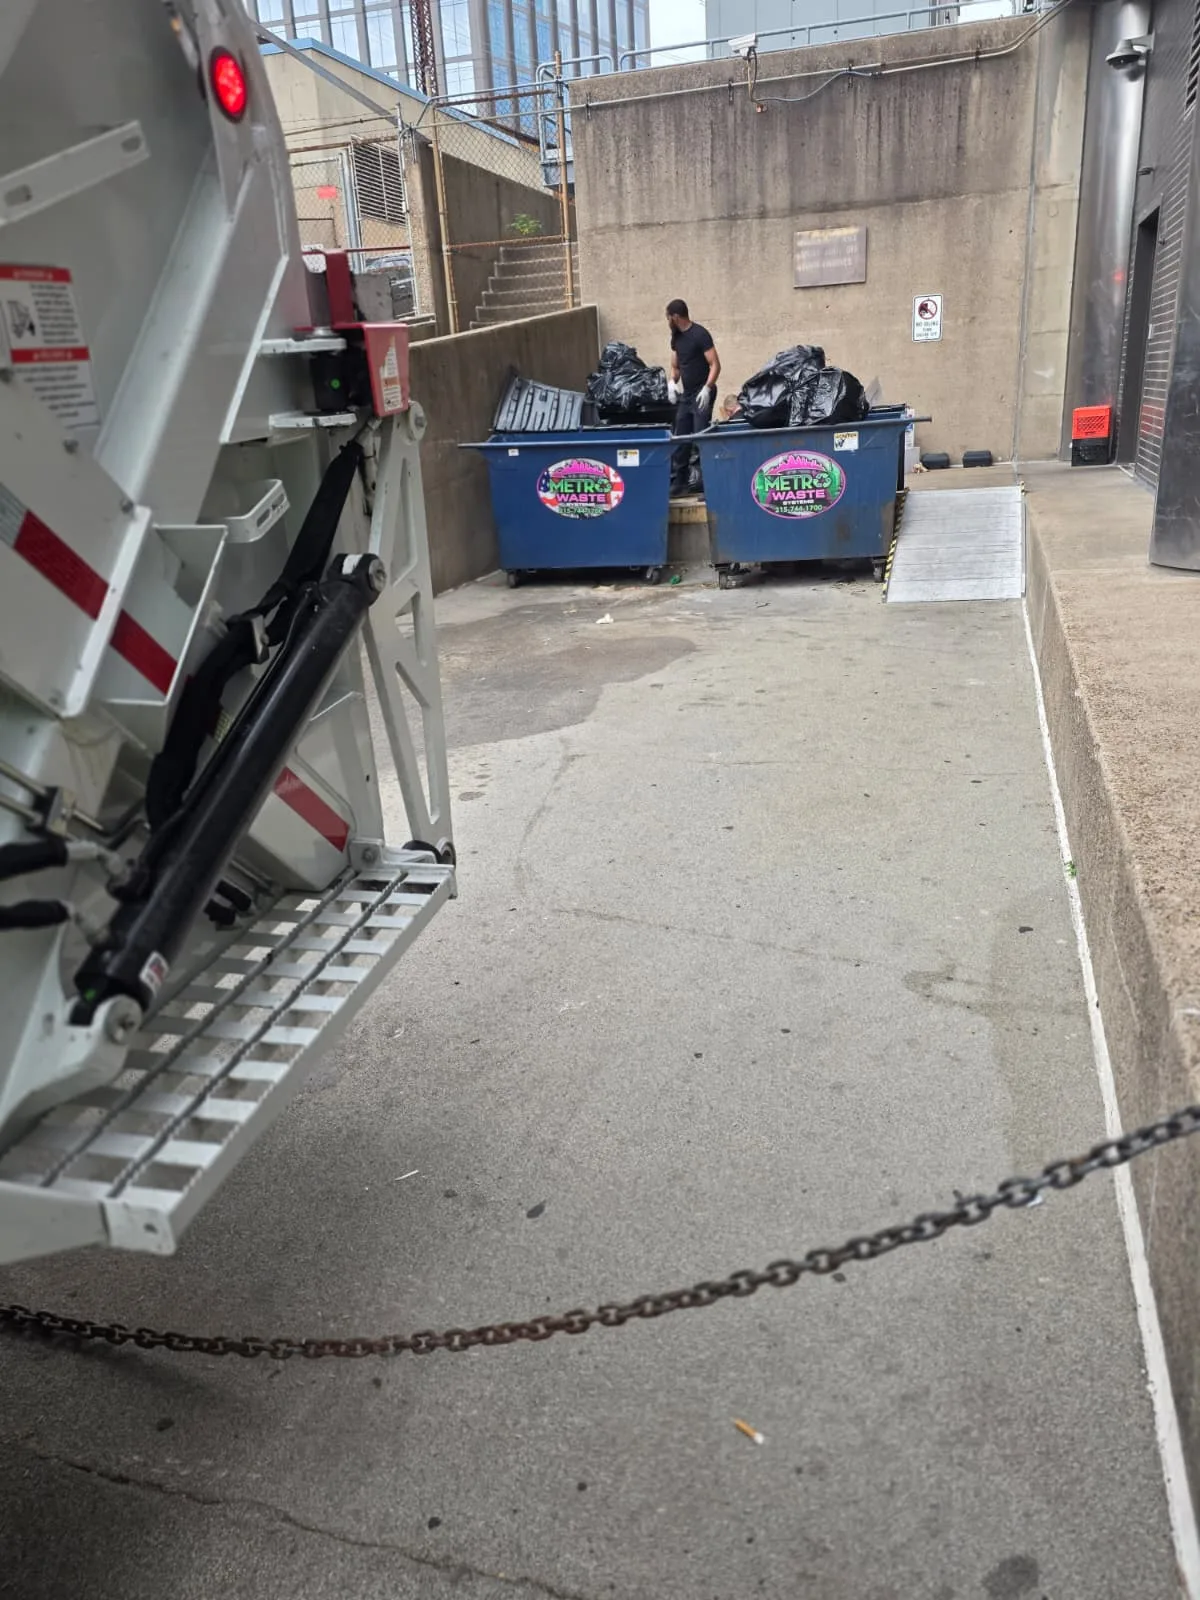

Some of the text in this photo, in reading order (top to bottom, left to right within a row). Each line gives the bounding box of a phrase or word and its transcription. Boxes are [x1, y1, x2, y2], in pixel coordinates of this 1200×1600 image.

[549, 478, 612, 493] METRO
[764, 473, 831, 491] METRO
[556, 493, 606, 503] WASTE
[772, 489, 825, 500] WASTE
